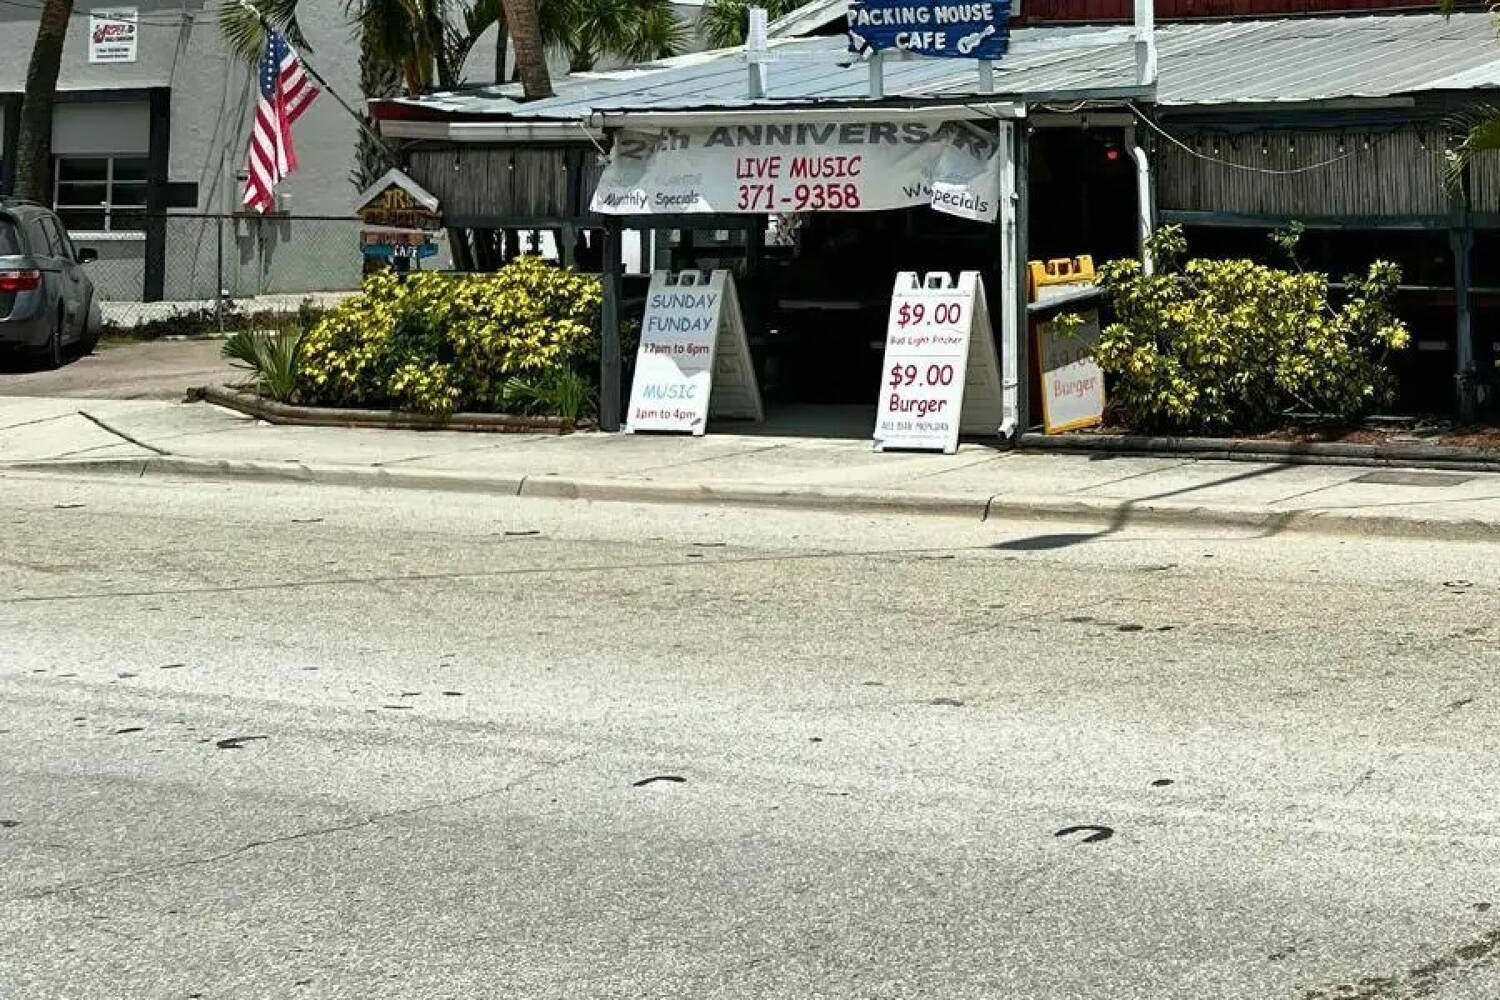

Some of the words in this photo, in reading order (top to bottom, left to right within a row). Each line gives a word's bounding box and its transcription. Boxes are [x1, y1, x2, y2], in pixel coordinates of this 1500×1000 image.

[847, 5, 931, 26] PACKING
[934, 2, 994, 24] HOUSE
[895, 31, 947, 50] CAFE
[736, 156, 781, 179] LIVE
[789, 155, 862, 179] MUSIC
[737, 183, 861, 211] 371-9358
[652, 294, 717, 309] SUNDAY
[647, 316, 713, 332] FUNDAY
[897, 301, 961, 328] $9.00
[674, 343, 684, 354] to
[686, 343, 709, 357] 6pm
[889, 362, 954, 389] $9.00
[643, 384, 697, 399] MUSIC
[1054, 377, 1096, 398] Burger
[635, 408, 658, 420] 1pm
[660, 409, 671, 419] to
[673, 409, 696, 421] 4pm
[890, 393, 947, 417] Burger
